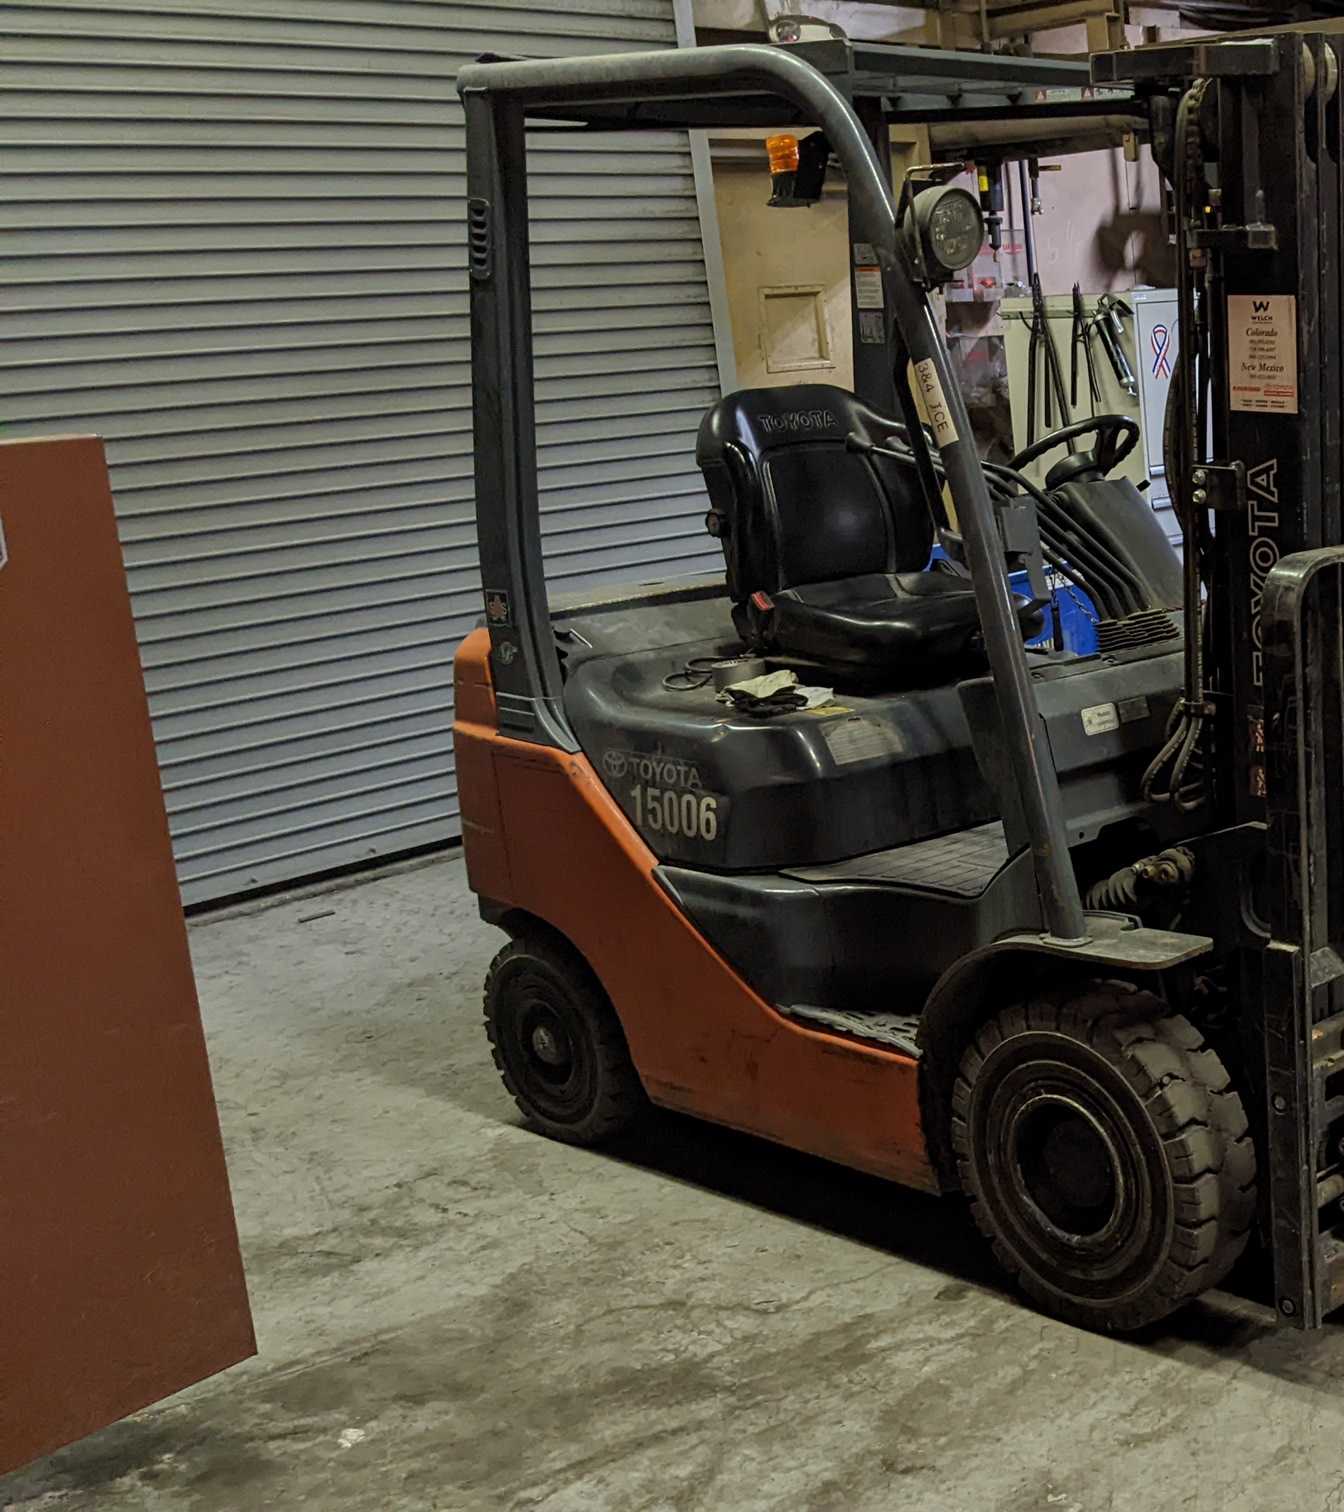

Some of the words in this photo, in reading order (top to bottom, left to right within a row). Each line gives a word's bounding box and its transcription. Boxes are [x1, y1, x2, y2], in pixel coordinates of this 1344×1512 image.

[1245, 327, 1278, 337] Colorado
[1241, 361, 1256, 373] New
[1257, 362, 1285, 374] Mexico
[759, 409, 839, 432] TOYOTA
[627, 758, 702, 787] TOYOTA
[631, 784, 718, 841] 15006
